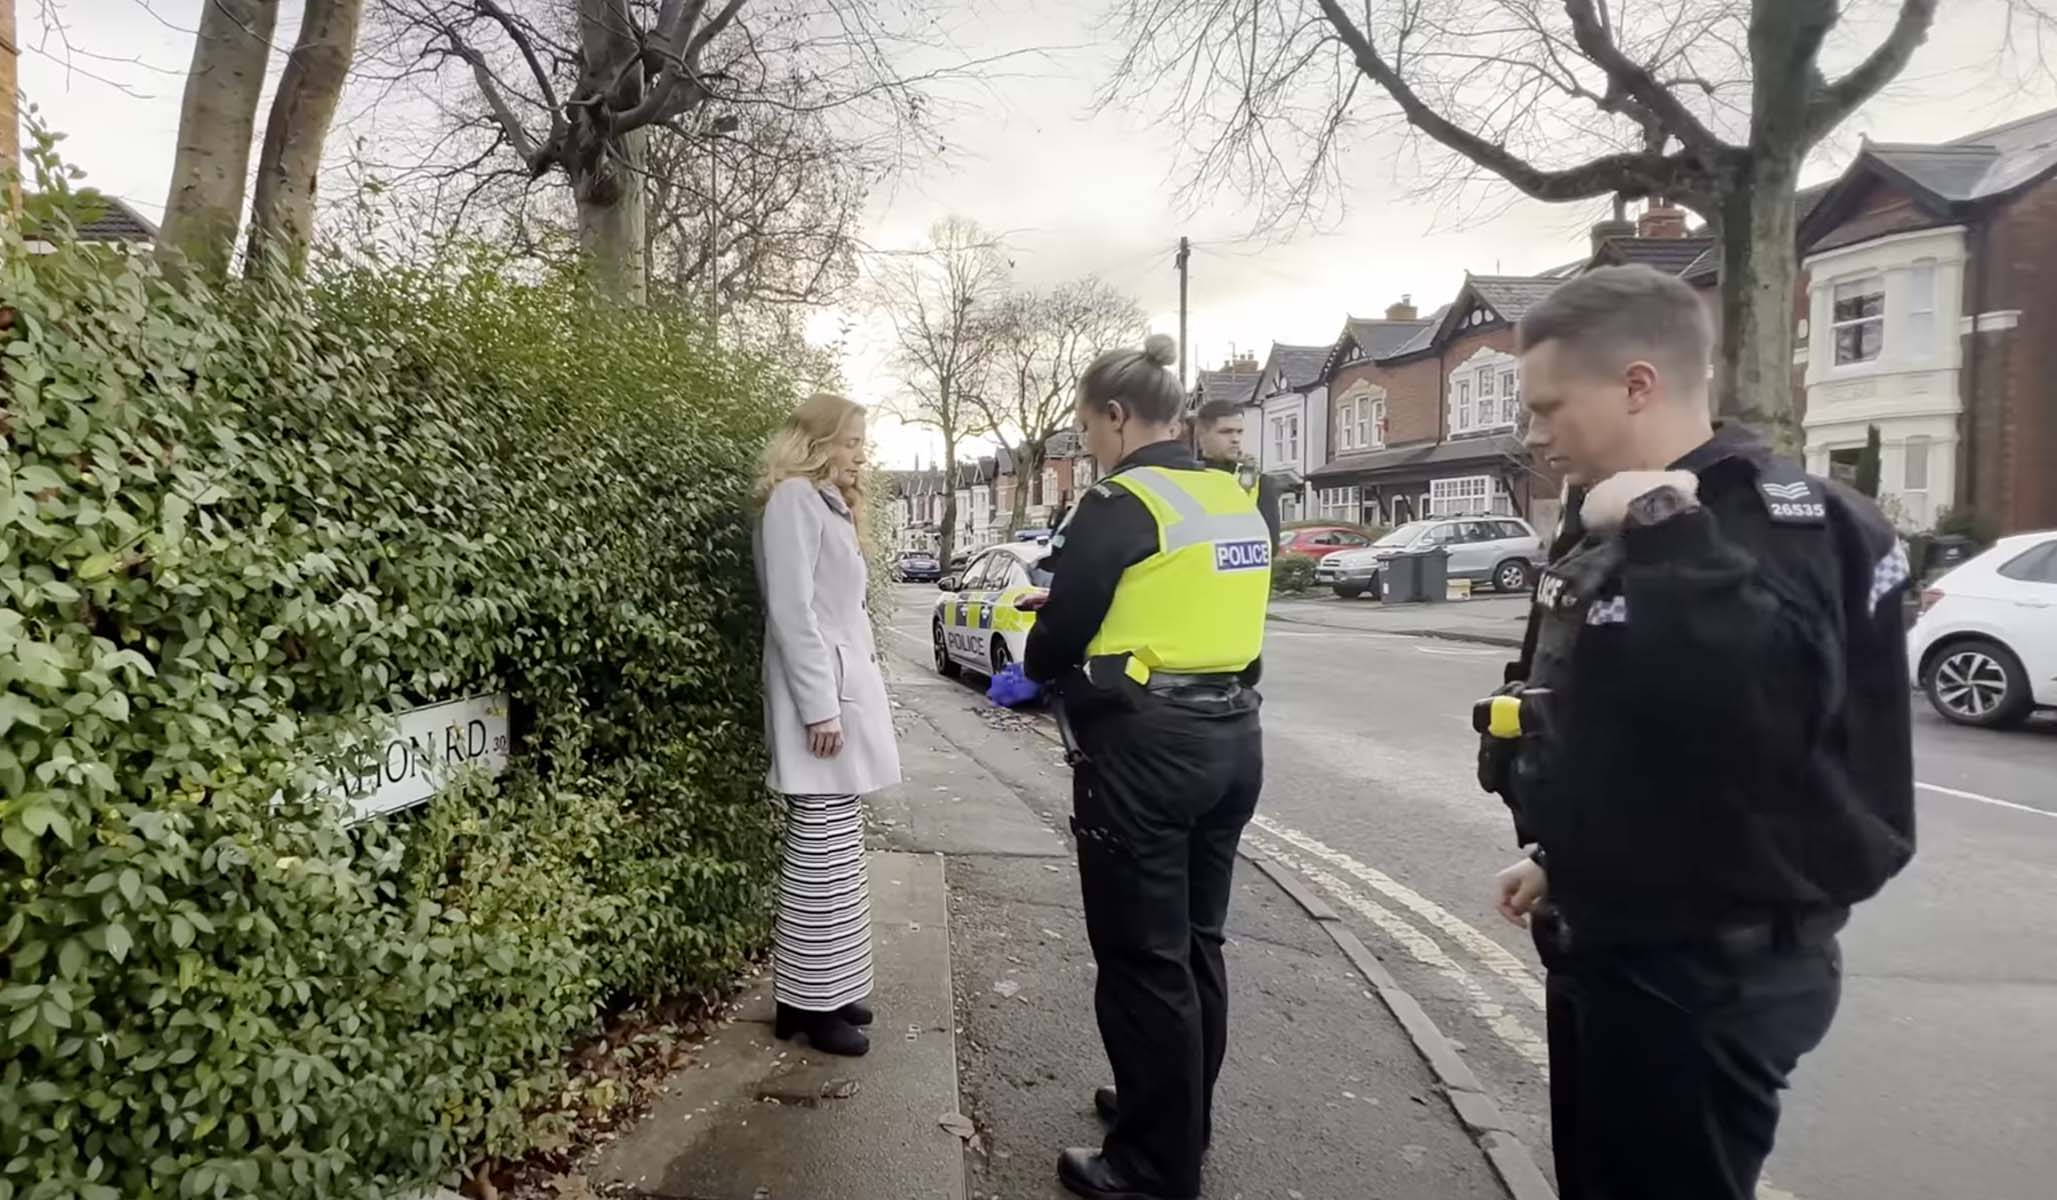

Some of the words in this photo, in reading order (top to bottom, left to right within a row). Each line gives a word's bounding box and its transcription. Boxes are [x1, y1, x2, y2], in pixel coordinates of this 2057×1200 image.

[1771, 503, 1825, 517] 26535
[1217, 543, 1269, 567] POLICE
[948, 632, 985, 656] POLICE
